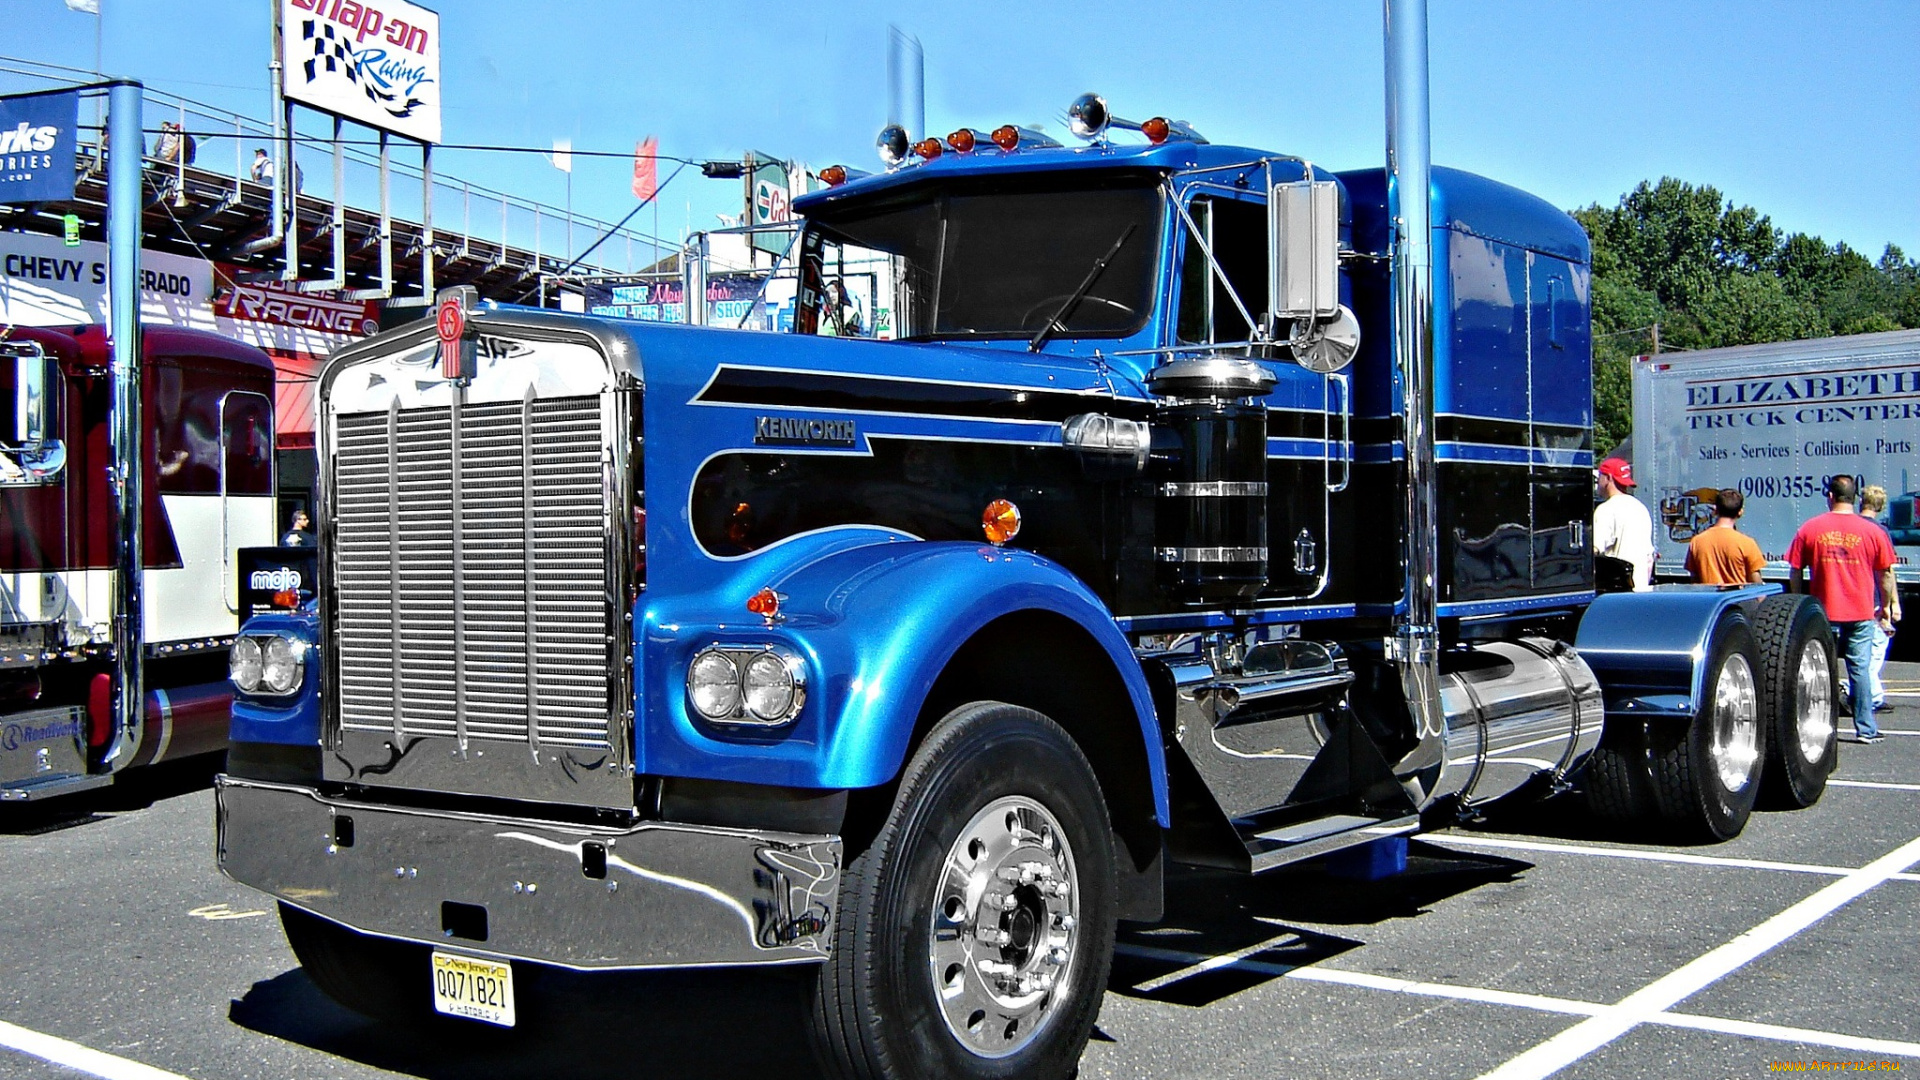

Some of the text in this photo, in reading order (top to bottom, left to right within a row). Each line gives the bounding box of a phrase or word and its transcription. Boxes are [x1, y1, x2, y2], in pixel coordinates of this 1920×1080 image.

[352, 49, 434, 97] Racing
[0, 122, 58, 154] rks
[6, 254, 84, 283] CHEVY
[614, 287, 647, 303] MEET
[229, 287, 354, 332] RACING
[1686, 371, 1920, 406] ELIZABETH
[755, 416, 856, 441] KENWORTH
[1686, 411, 1786, 430] TRUCK
[1699, 438, 1911, 460] Sales Services Collision Parts
[1738, 474, 1865, 499] (908)355-80
[251, 567, 301, 592] mojo
[451, 958, 490, 974] New Jersey
[437, 968, 505, 1008] QQ71821
